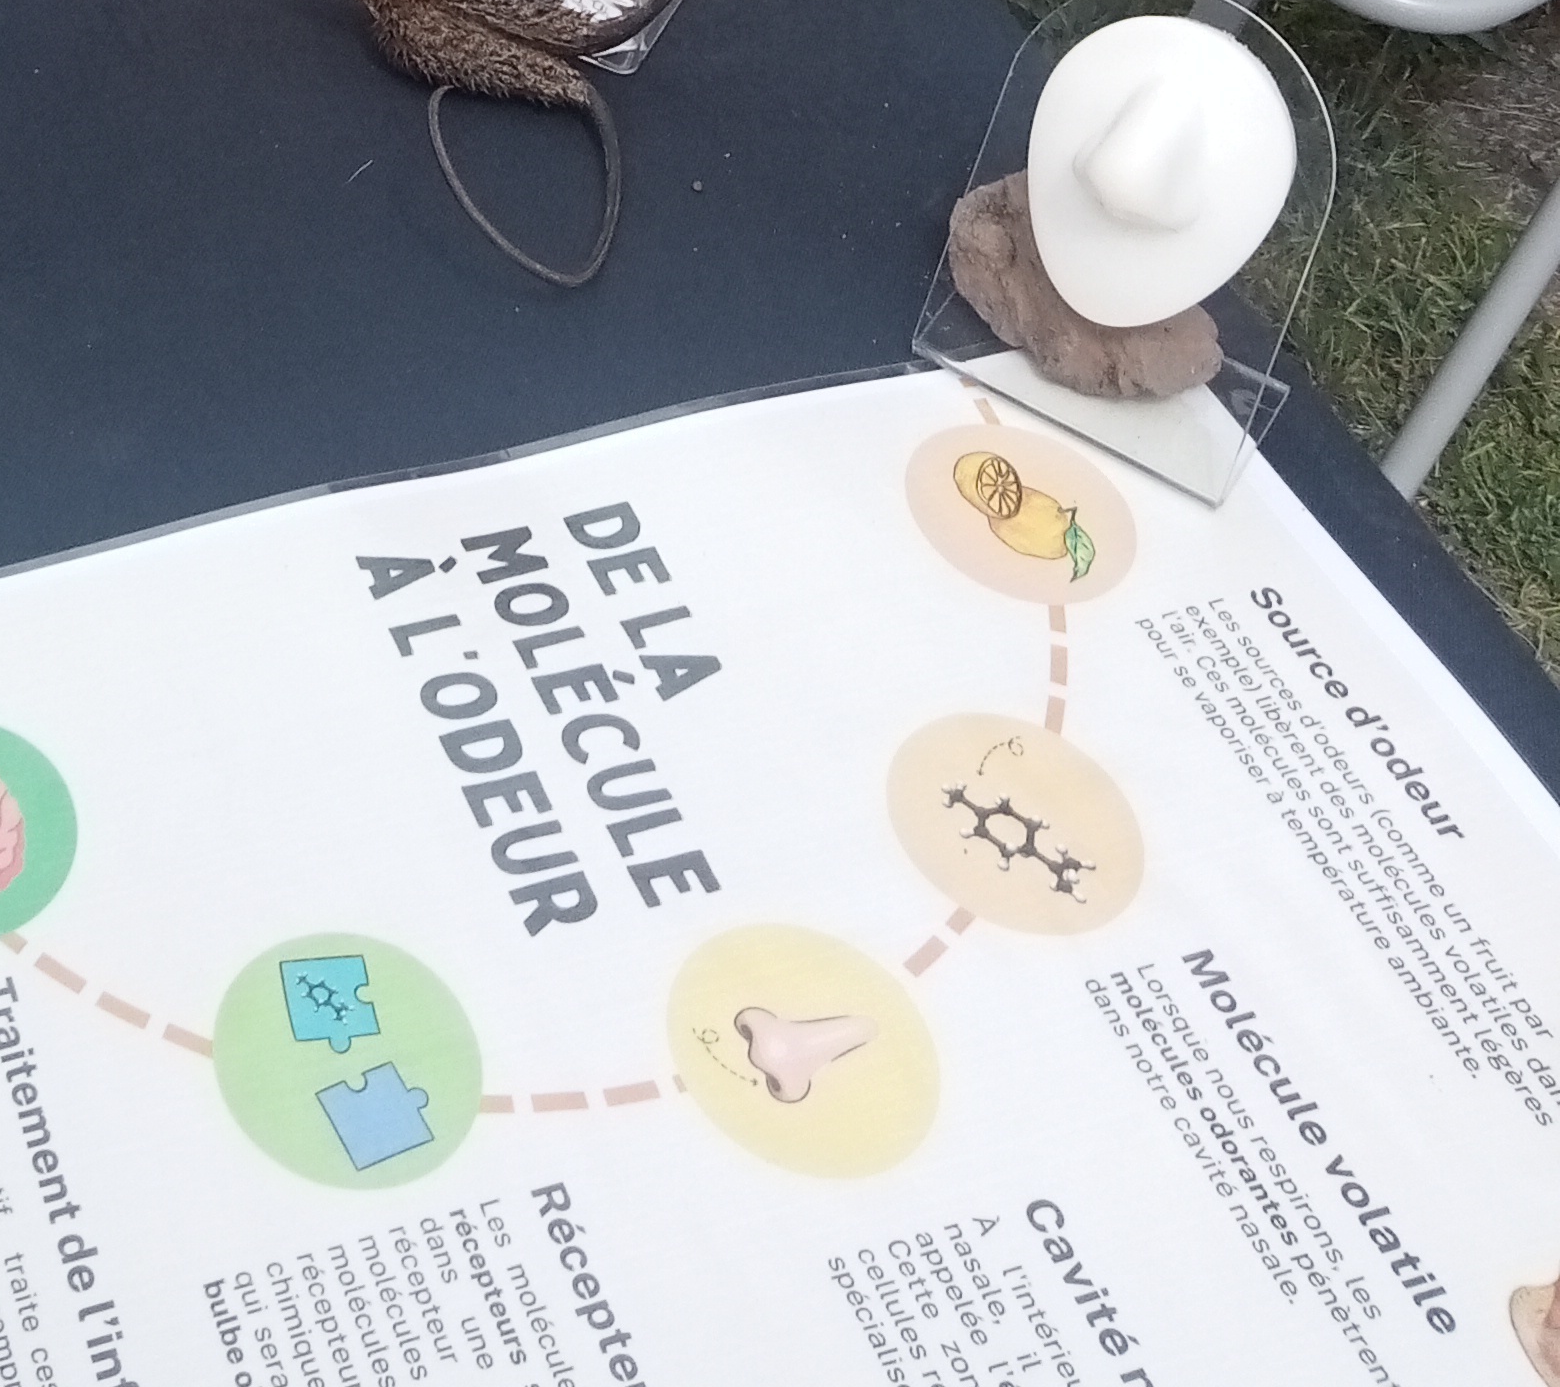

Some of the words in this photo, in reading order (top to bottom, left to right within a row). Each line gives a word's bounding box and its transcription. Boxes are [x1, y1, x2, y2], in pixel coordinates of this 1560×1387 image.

[355, 555, 458, 601] À
[561, 499, 672, 598] DE
[618, 603, 723, 702] LA
[387, 613, 600, 939] L'ODEUR
[458, 525, 723, 910] MOLÉCULE
[1249, 586, 1349, 699] Source
[1344, 705, 1465, 838] d'odeur
[1134, 617, 1177, 658] pour
[1173, 665, 1196, 688] se
[1194, 691, 1269, 783] vaporiser
[1265, 790, 1284, 804] à
[1280, 808, 1390, 950] température
[1386, 956, 1479, 1079] ambiante.
[1161, 610, 1195, 644] l'air.
[1195, 655, 1229, 693] Ces
[1225, 695, 1310, 801] molécules
[1307, 805, 1352, 855] sont
[1347, 858, 1478, 1024] suffisamment
[1473, 1027, 1553, 1126] légères
[1185, 605, 1262, 692] exemple)
[1254, 695, 1324, 777] libèrent
[1319, 780, 1354, 819] des
[1351, 823, 1446, 940] molécules
[1444, 944, 1528, 1051] volatiles
[1207, 597, 1240, 632] Les
[1236, 635, 1302, 711] sources
[1298, 714, 1374, 805] d'odeurs
[1369, 808, 1445, 897] (comme
[1442, 902, 1472, 933] un
[1469, 936, 1517, 992] fruit
[1508, 997, 1554, 1038] par
[1084, 978, 1130, 1037] dans
[1125, 1042, 1176, 1110] notre
[1173, 1116, 1233, 1197] cavité
[1228, 1203, 1298, 1304] nasale.
[1109, 971, 1203, 1101] molécules
[1199, 1106, 1298, 1246] odorantes
[1289, 1252, 1399, 1387] pénètren
[1136, 962, 1209, 1062] Lorsque
[1204, 1068, 1255, 1129] nous
[1249, 1135, 1344, 1271] respirons,
[1344, 1275, 1381, 1319] les
[1181, 948, 1327, 1146] Molécule
[1324, 1153, 1456, 1334] volatile
[3, 1251, 39, 1332] traite
[56, 1233, 98, 1293] de
[233, 1271, 268, 1315] qui
[388, 1225, 458, 1362] récepteur
[419, 1217, 458, 1284] dans
[460, 1315, 493, 1369] une
[449, 1208, 527, 1365] récepteurs
[478, 1198, 511, 1248] Les
[887, 1239, 939, 1319] Cette
[914, 1231, 988, 1345] appelée
[943, 1222, 1005, 1324] nasale,
[1016, 1351, 1042, 1372] il
[971, 1215, 1000, 1237] À
[1025, 1198, 1140, 1357] Cavité
[202, 1277, 244, 1364] bulbe
[357, 1234, 428, 1381] molécules
[857, 1248, 927, 1360] cellules
